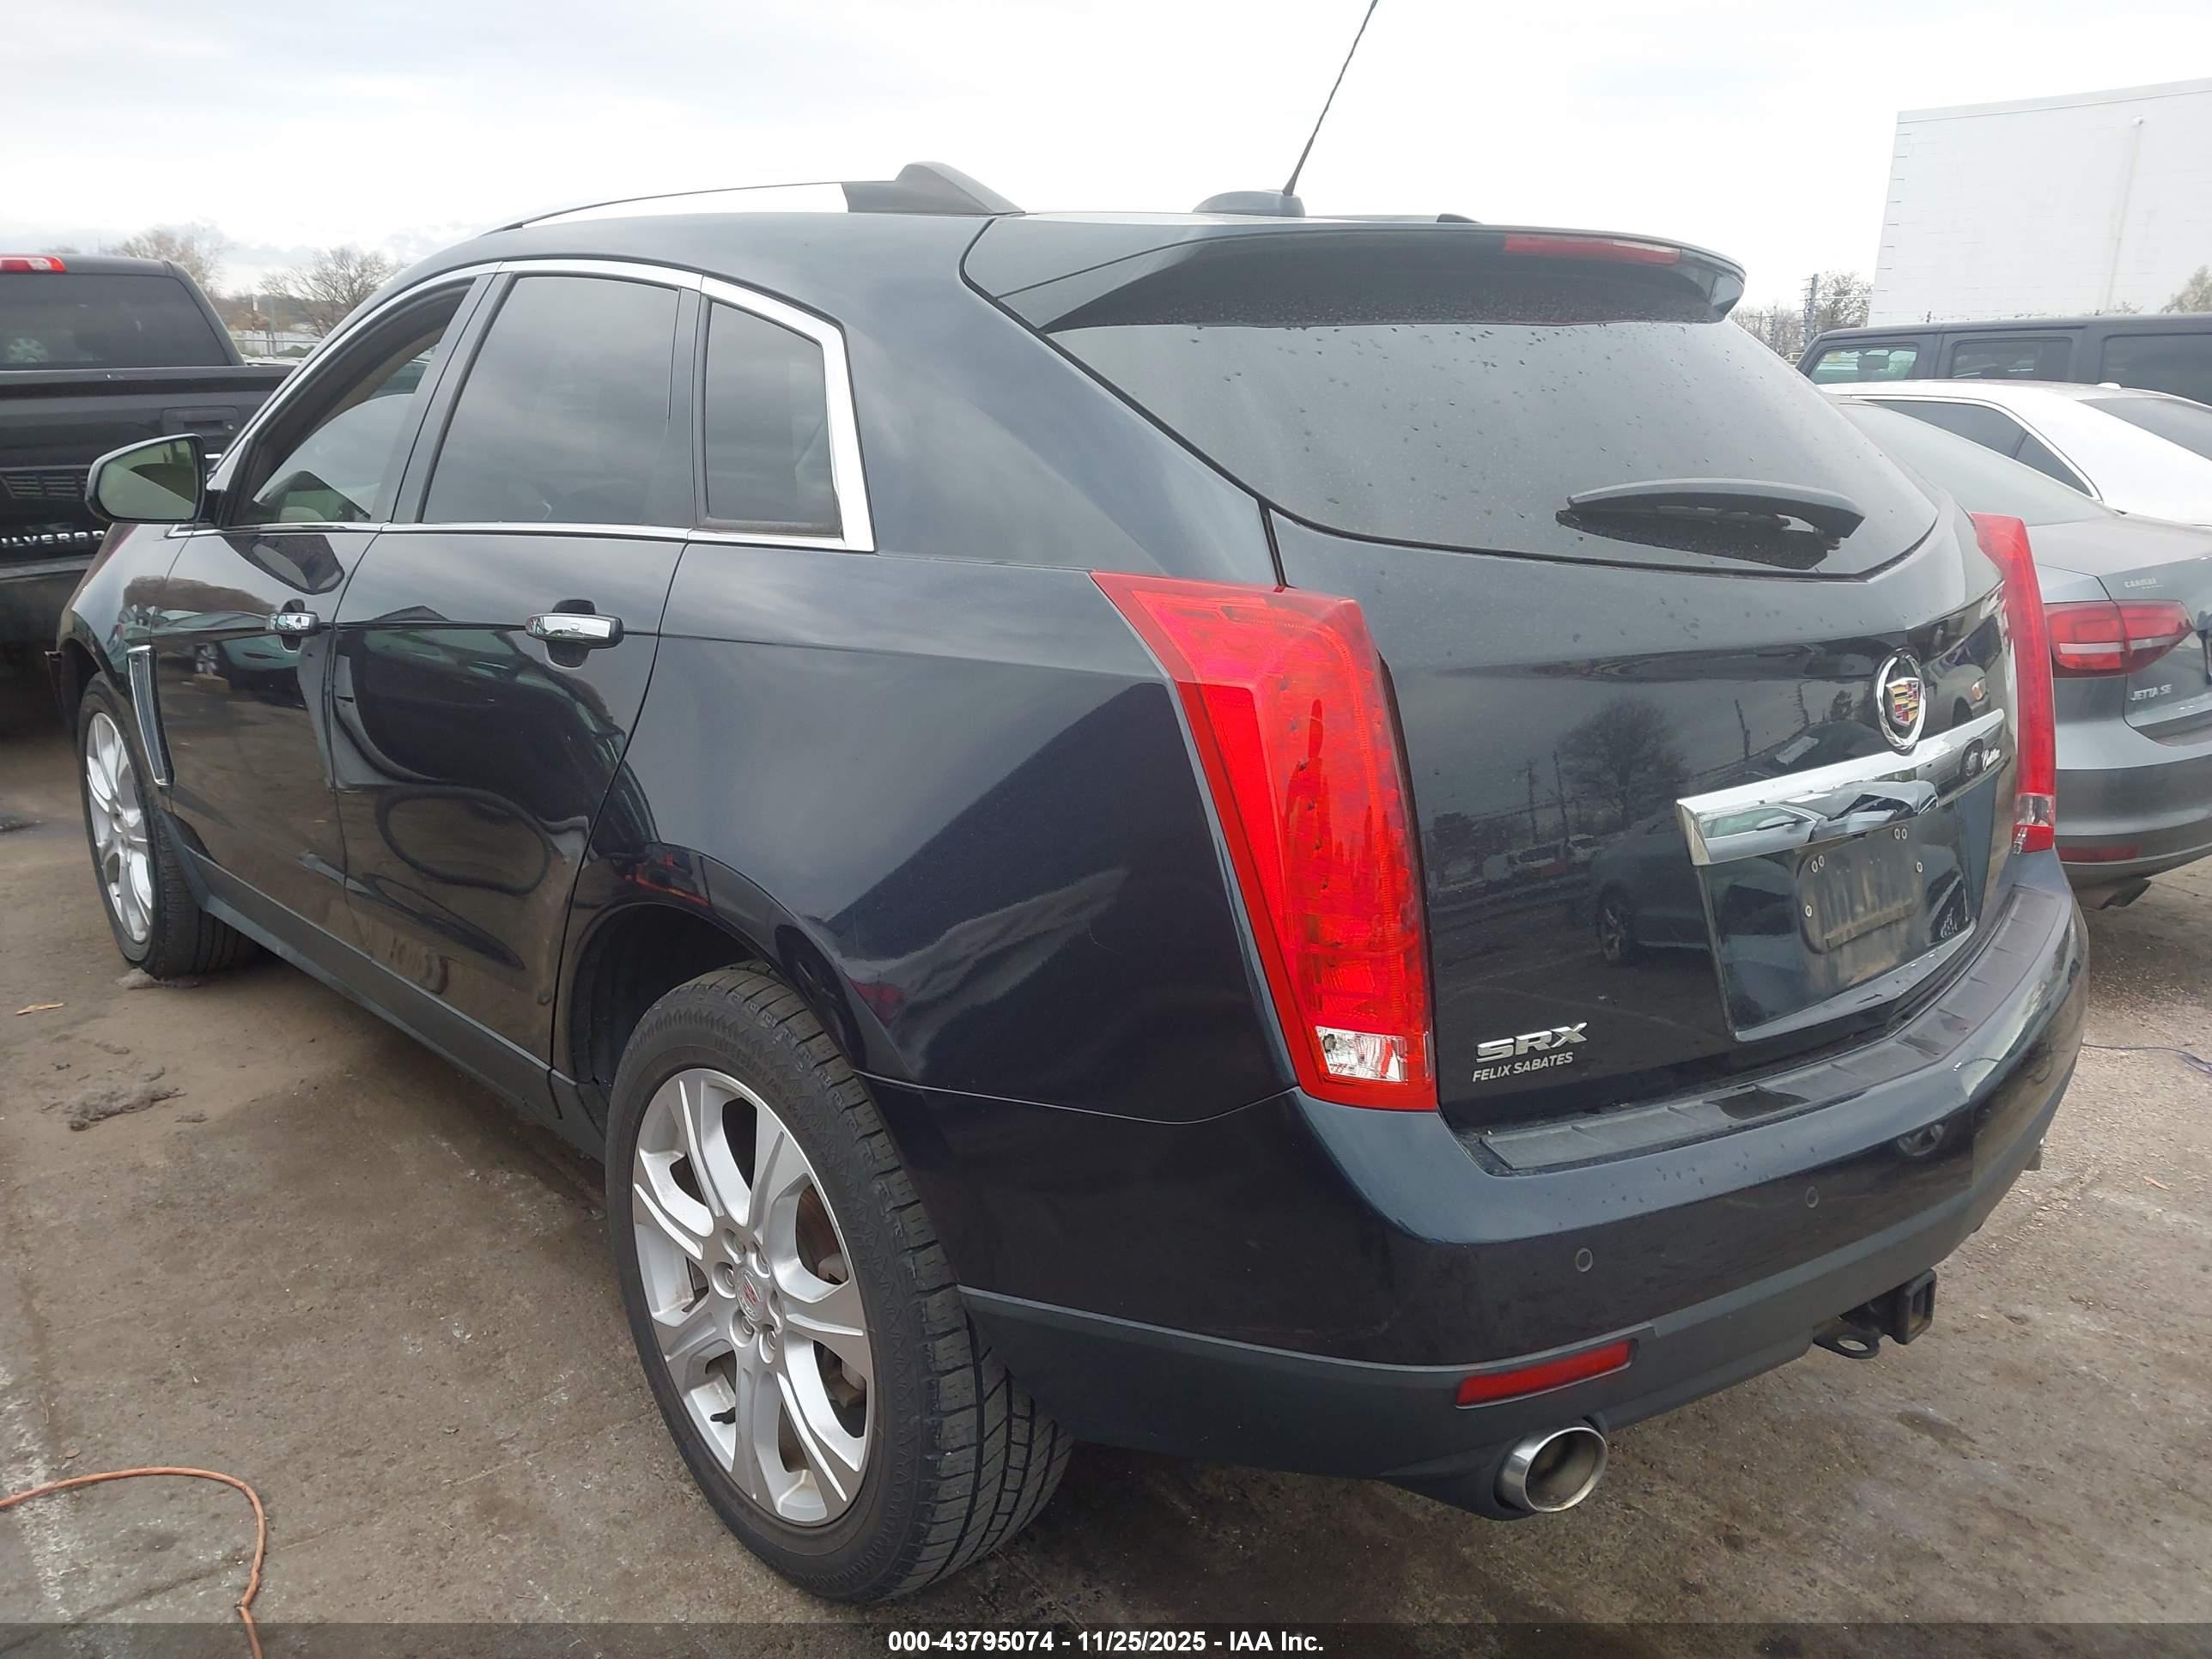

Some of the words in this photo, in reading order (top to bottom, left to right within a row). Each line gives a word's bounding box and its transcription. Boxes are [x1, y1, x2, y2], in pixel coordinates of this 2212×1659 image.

[2130, 687, 2158, 701] JETTA
[2160, 684, 2172, 696] SE
[1475, 1022, 1588, 1063] SRX
[1472, 1064, 1512, 1082] FELIX
[1512, 1051, 1574, 1074] SABATES
